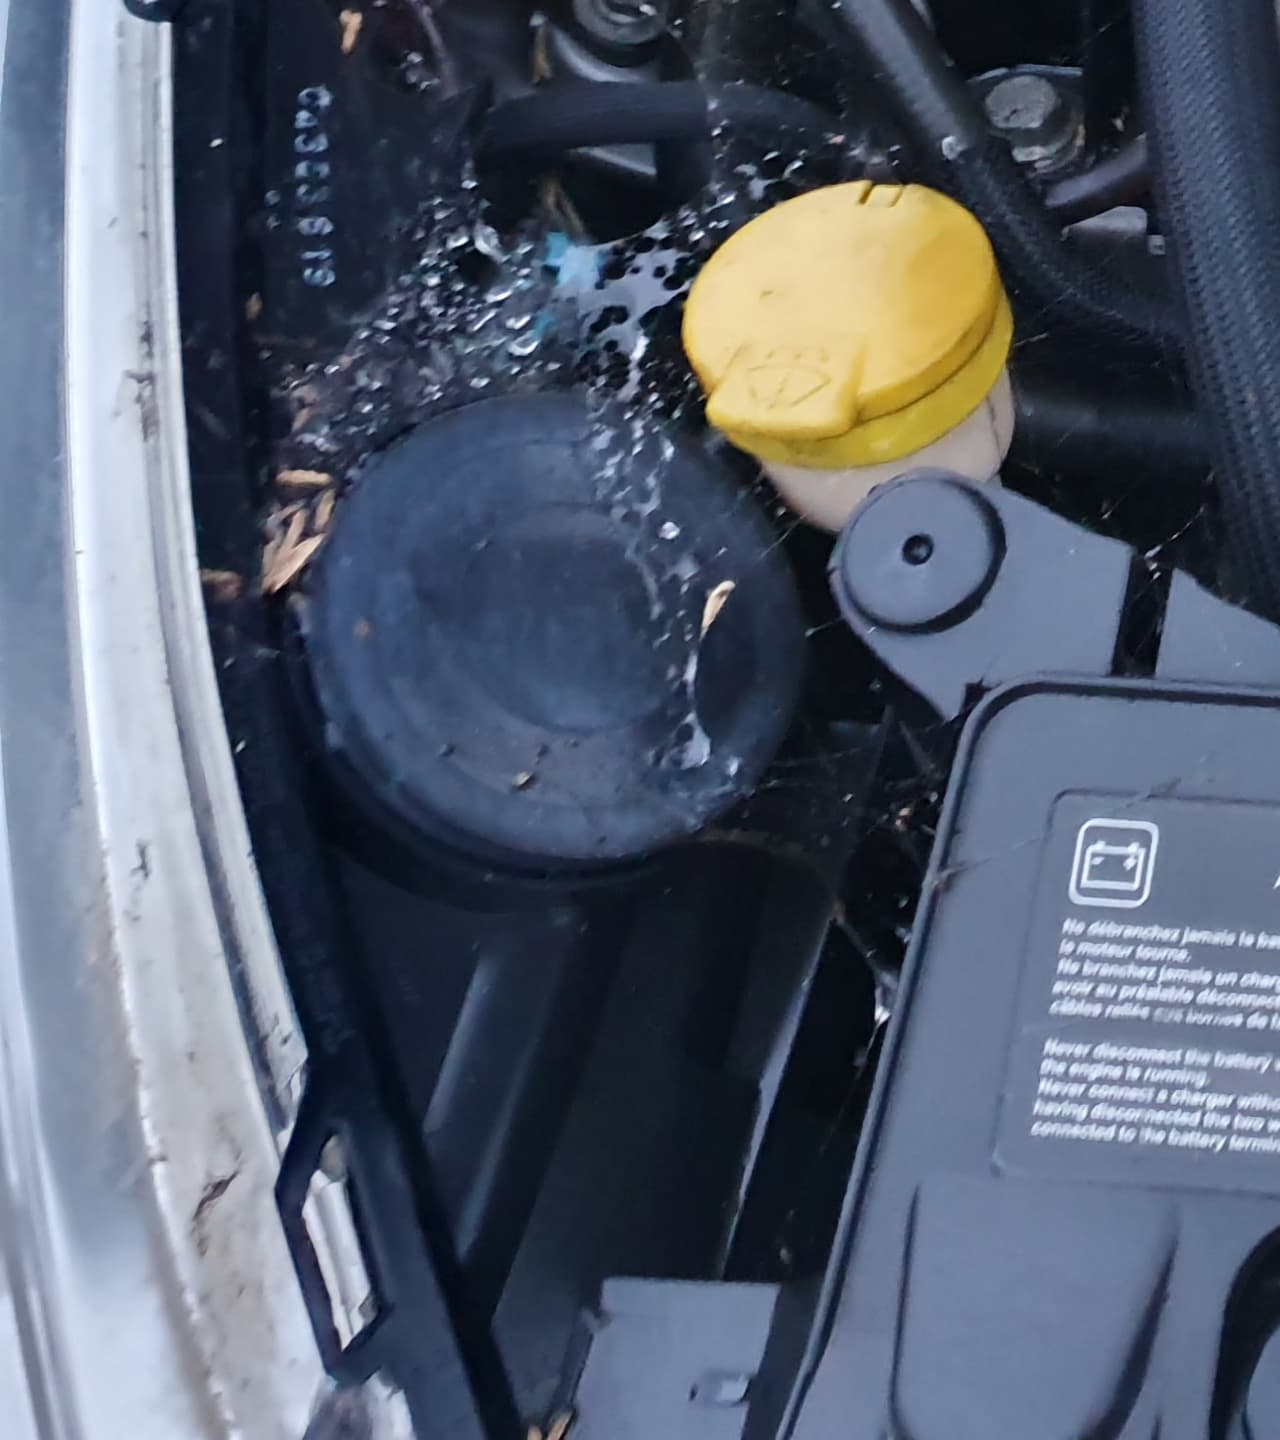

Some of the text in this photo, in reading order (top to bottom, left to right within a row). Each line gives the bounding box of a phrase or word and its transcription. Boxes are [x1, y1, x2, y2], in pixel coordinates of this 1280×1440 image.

[1042, 1038, 1090, 1058] Never
[1213, 1051, 1273, 1075] battery
[1039, 1058, 1066, 1076] the
[1067, 1060, 1123, 1084] engine
[1037, 1078, 1086, 1097] Never
